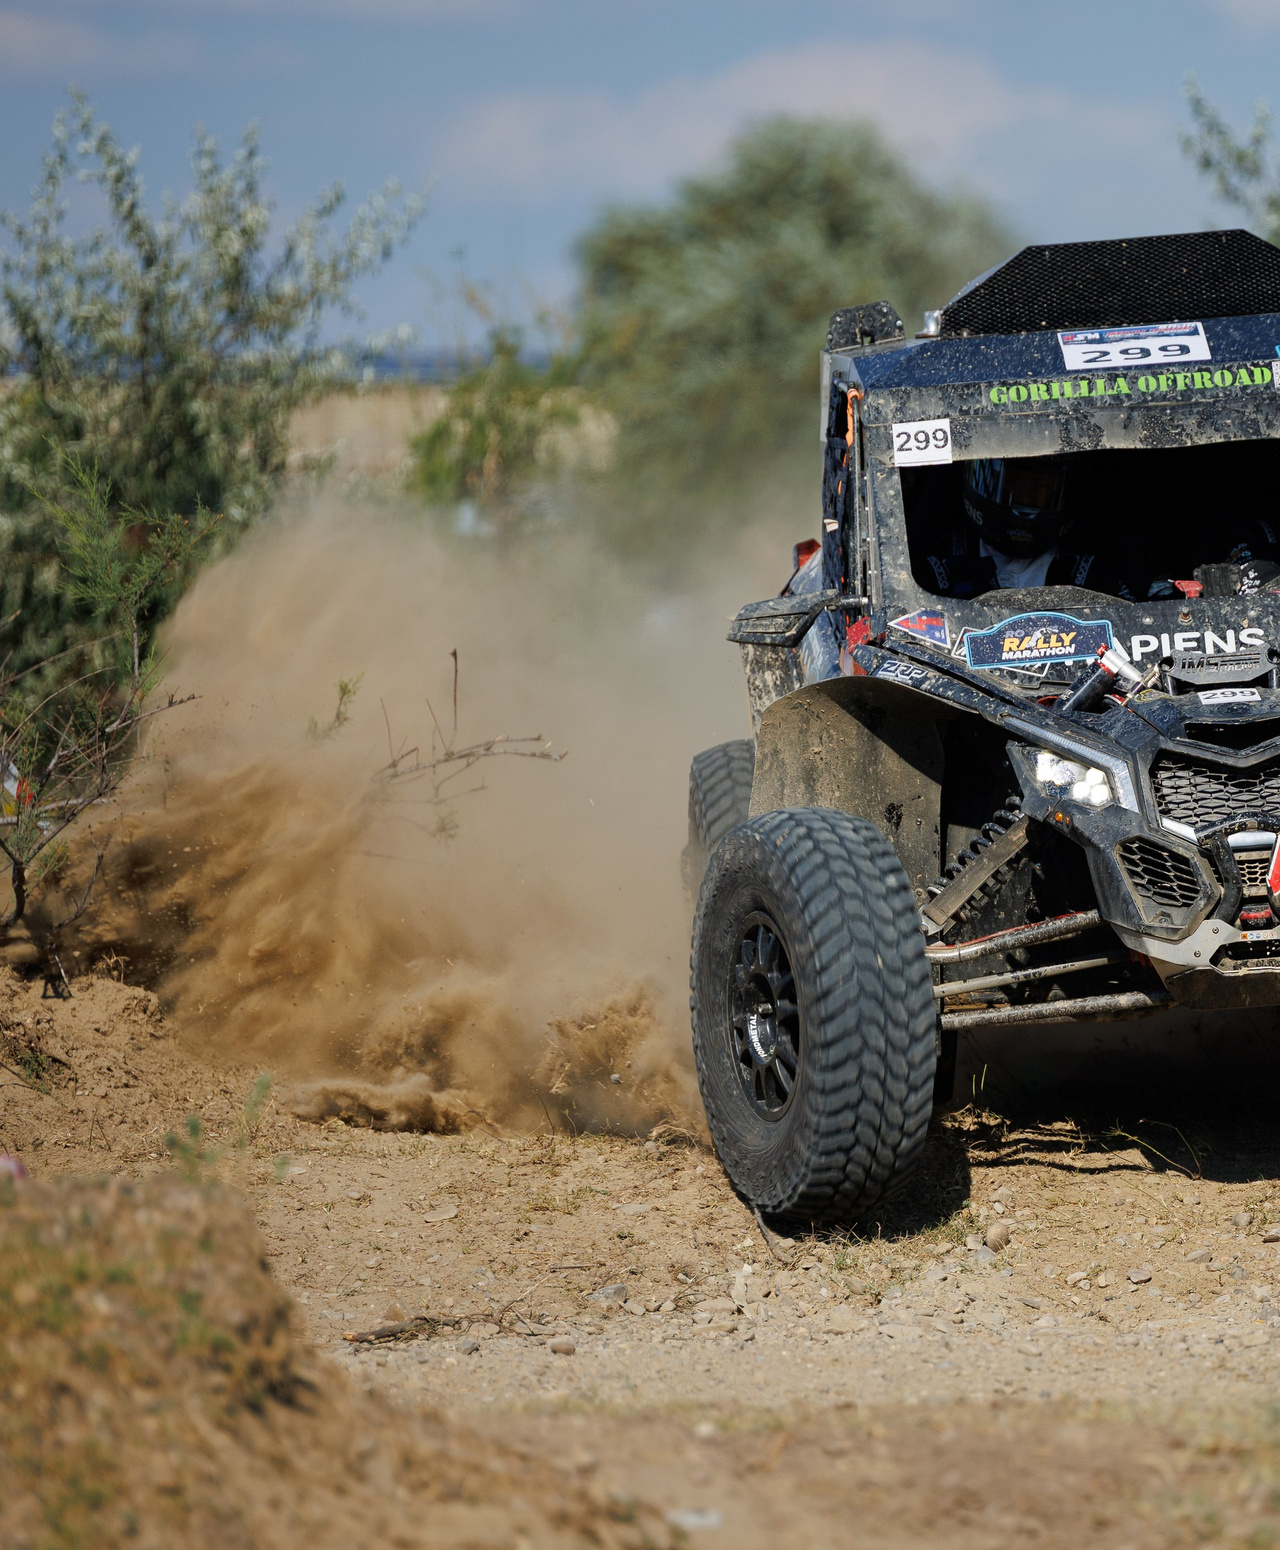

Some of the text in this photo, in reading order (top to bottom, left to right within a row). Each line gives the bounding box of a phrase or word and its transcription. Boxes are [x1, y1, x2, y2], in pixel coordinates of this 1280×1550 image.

[1081, 343, 1191, 364] 299
[989, 367, 1272, 405] GORILLA OFFROAD
[895, 428, 949, 452] 299
[1001, 643, 1076, 660] MARATHON
[1003, 632, 1077, 652] RALLY
[1086, 627, 1265, 663] PIENS
[878, 660, 929, 679] ZRP
[1202, 690, 1257, 700] 299
[750, 1013, 768, 1058] FONDMETAL
